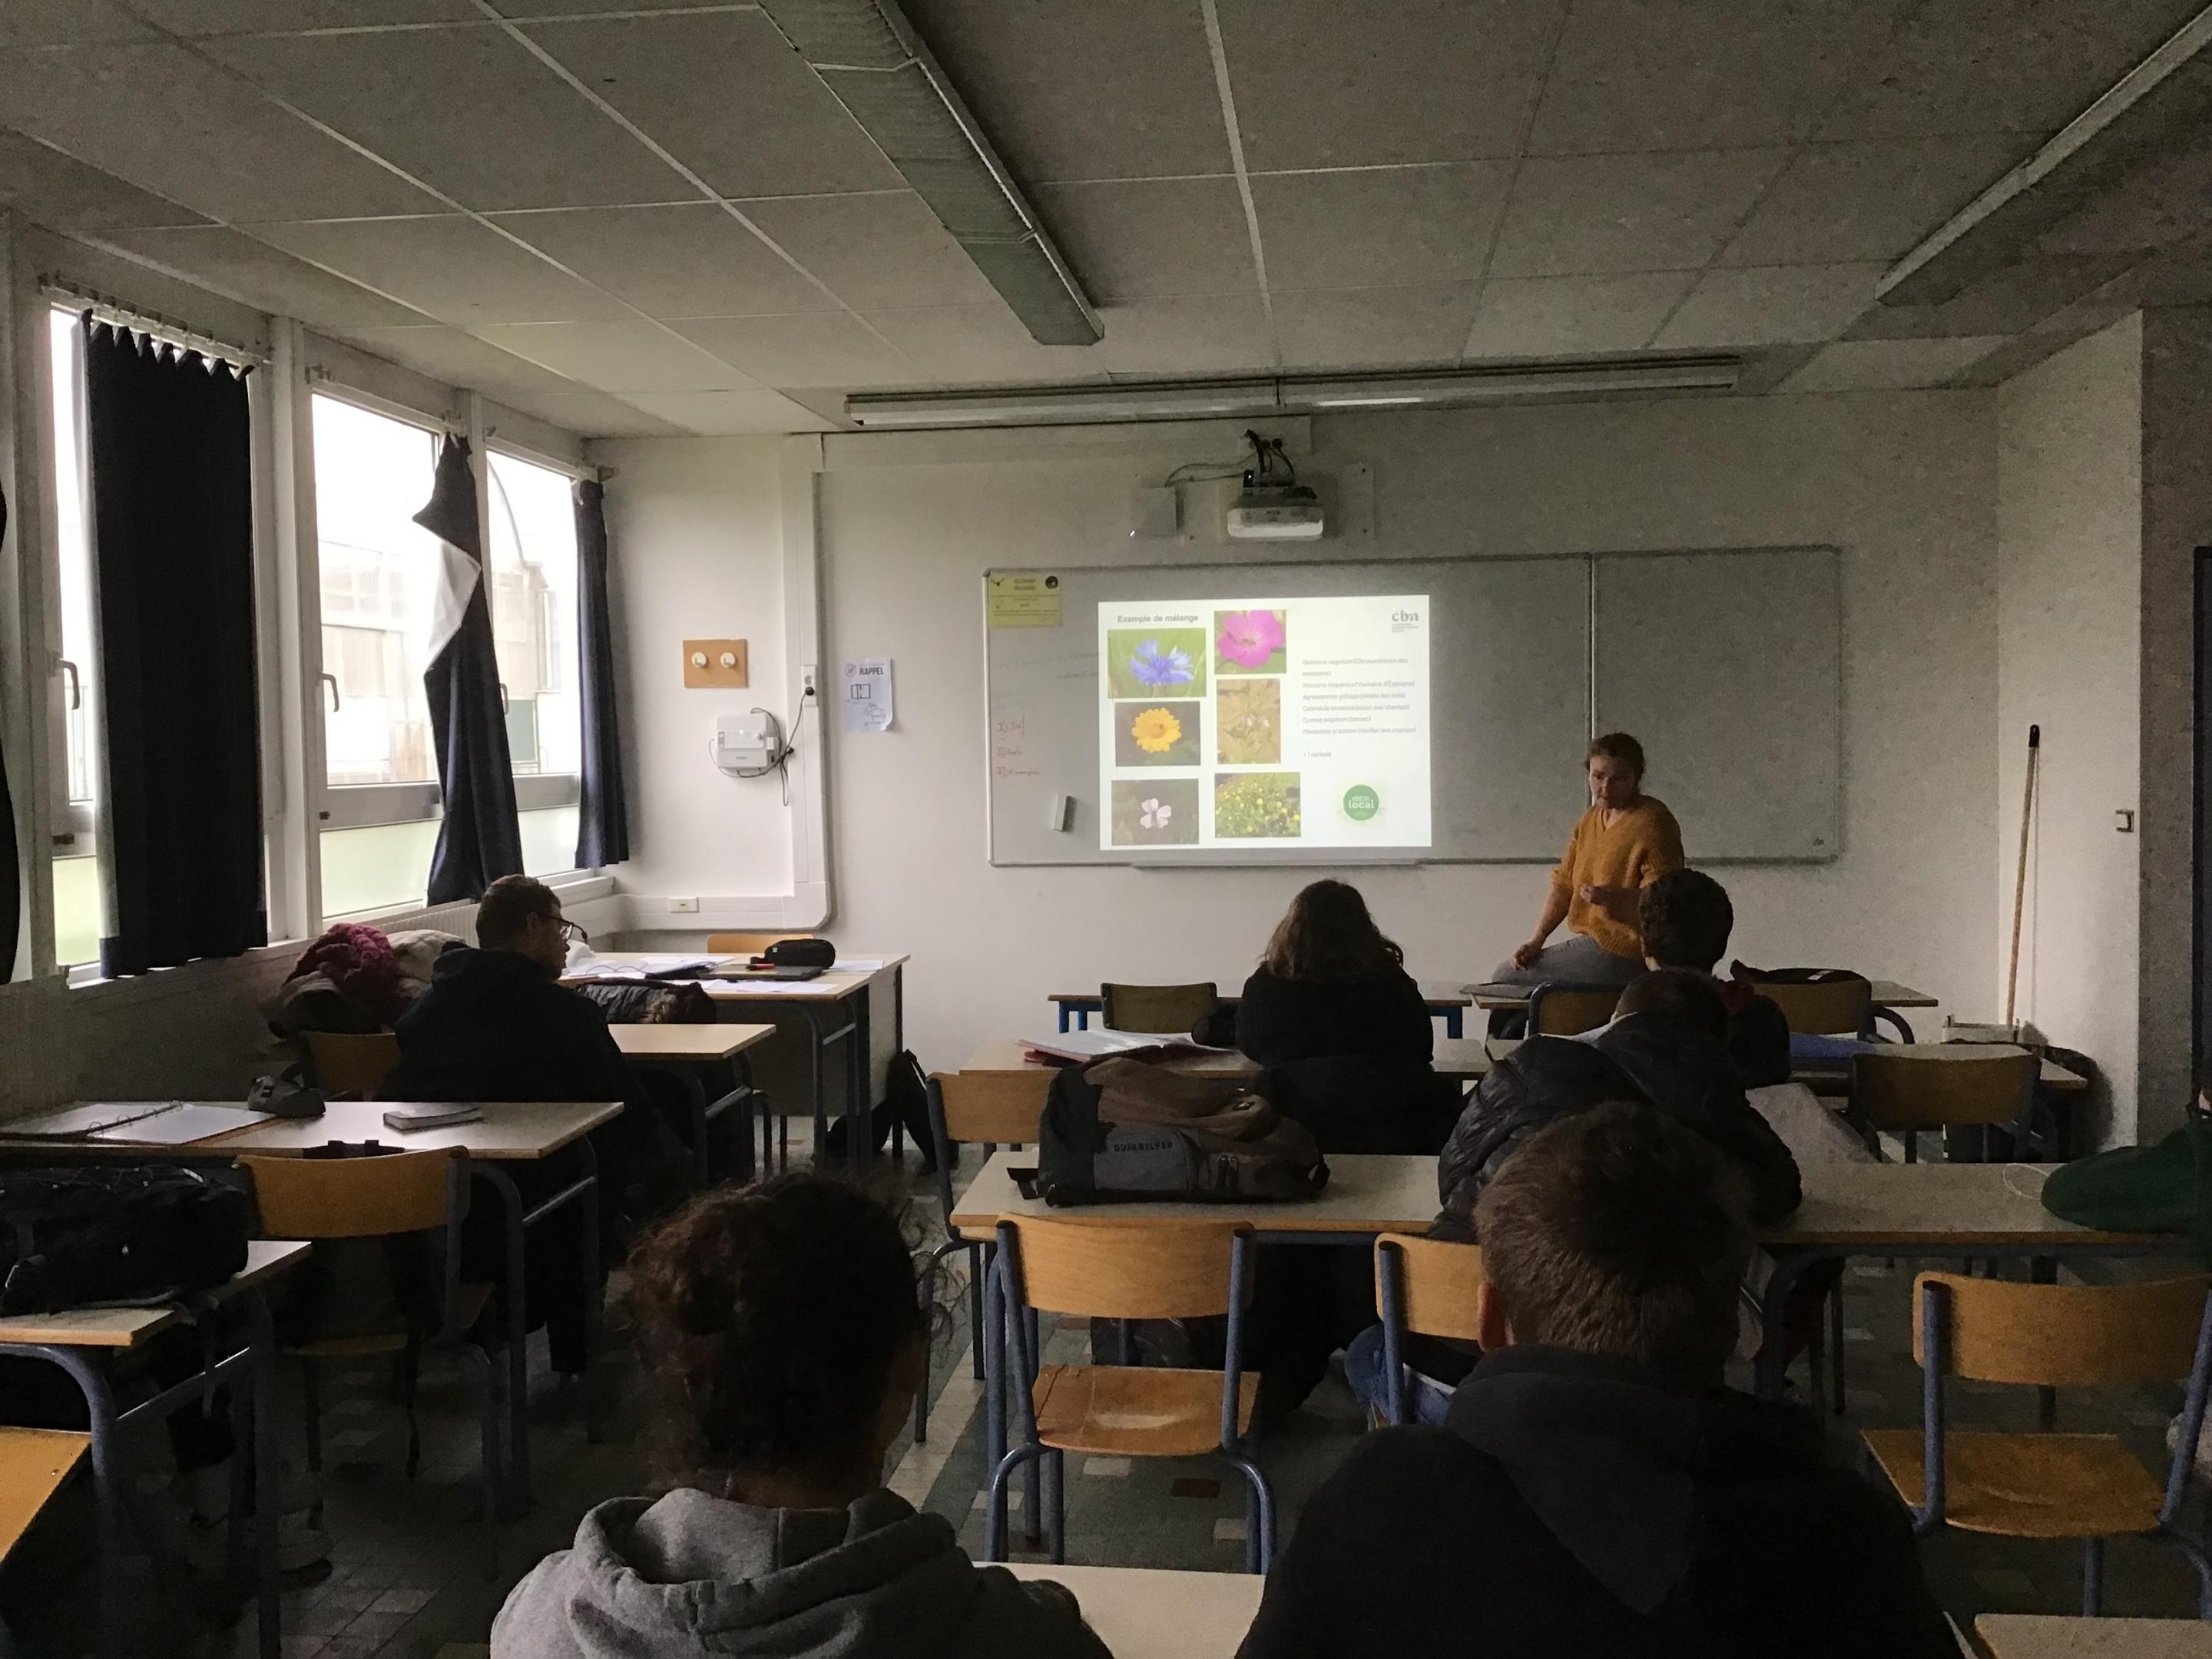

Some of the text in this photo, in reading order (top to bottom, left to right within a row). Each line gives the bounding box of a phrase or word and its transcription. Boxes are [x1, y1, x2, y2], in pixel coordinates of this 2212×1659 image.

[1118, 614, 1198, 624] Exemple de mélange
[1392, 609, 1419, 622] cbn
[859, 667, 885, 676] RAPPEL
[1348, 799, 1374, 809] local
[1114, 1141, 1173, 1152] QUIKSILVER
